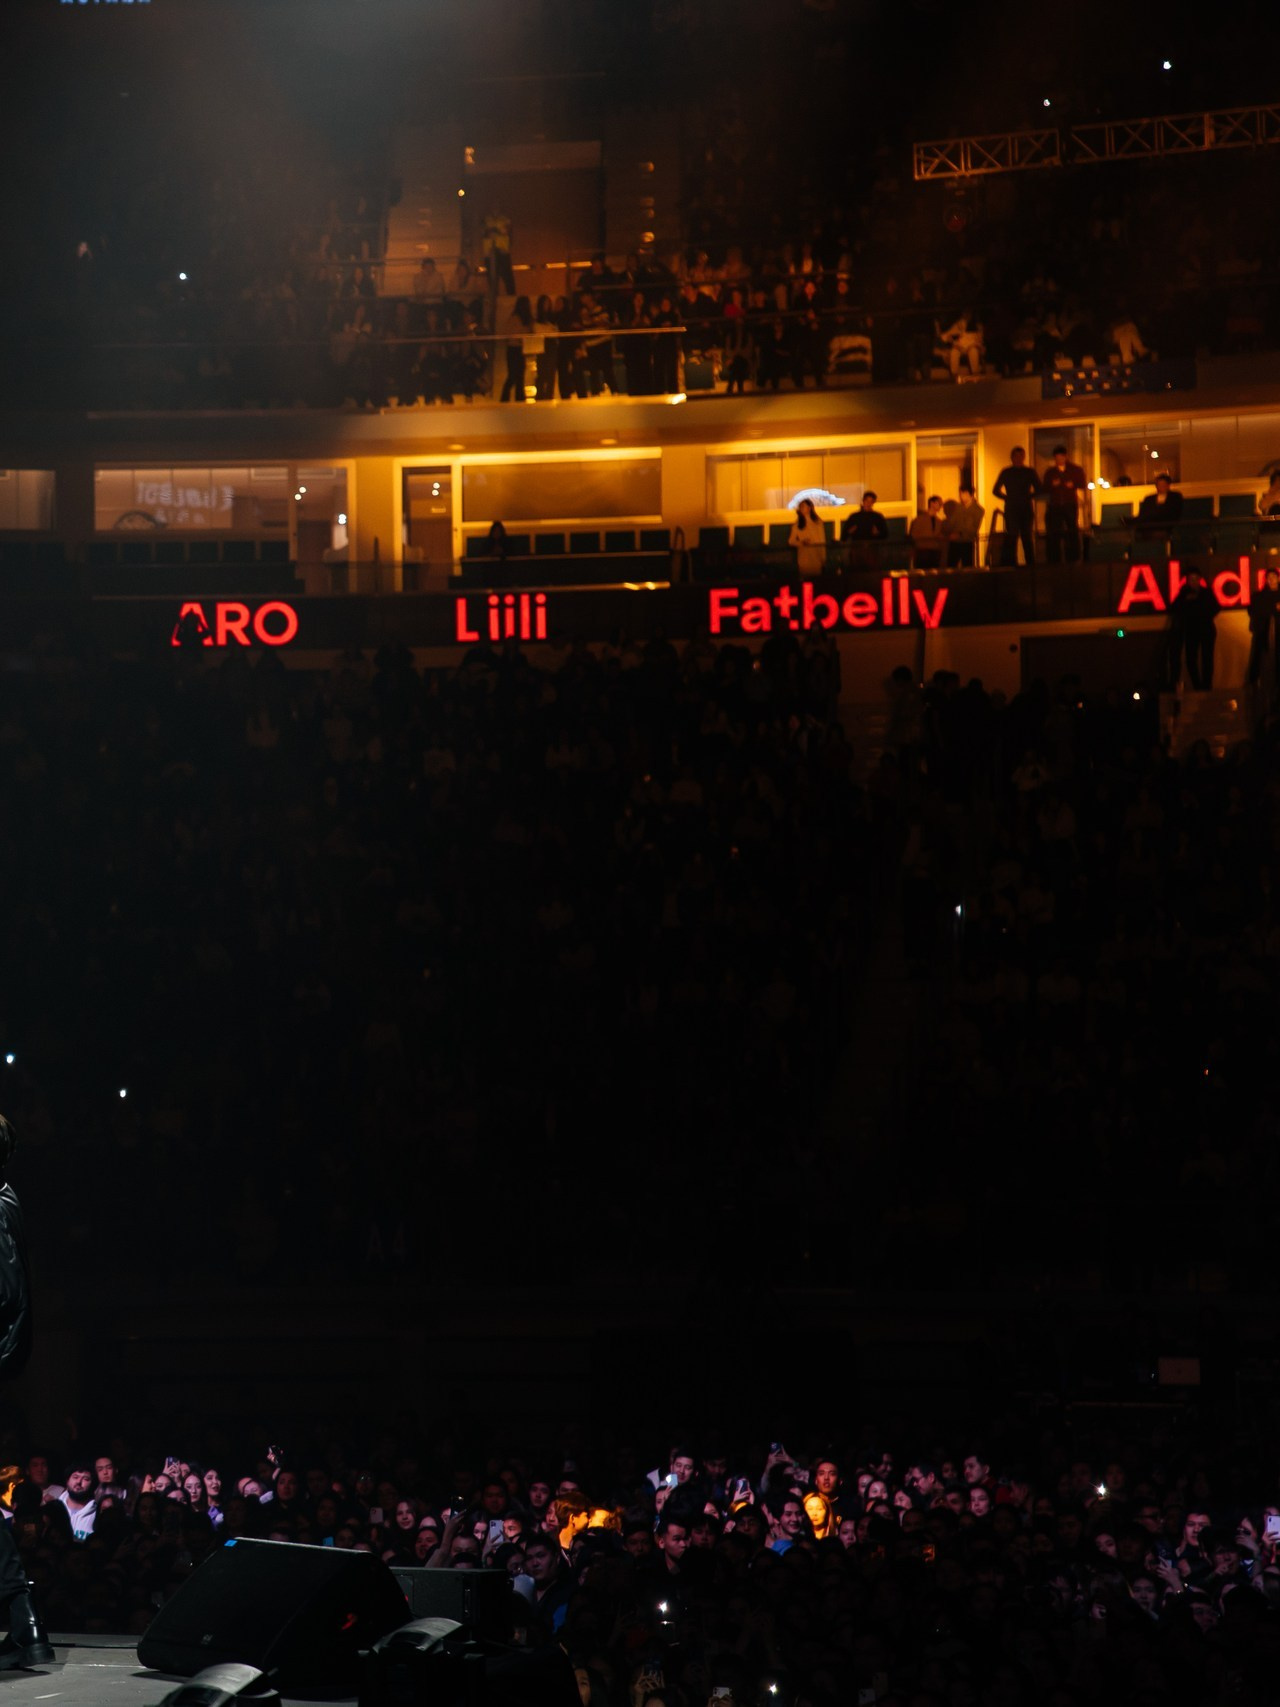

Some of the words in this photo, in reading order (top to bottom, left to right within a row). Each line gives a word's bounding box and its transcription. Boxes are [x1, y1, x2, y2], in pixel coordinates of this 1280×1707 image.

[1117, 556, 1280, 613] Ad
[171, 601, 299, 647] ARO
[455, 593, 548, 642] Liili
